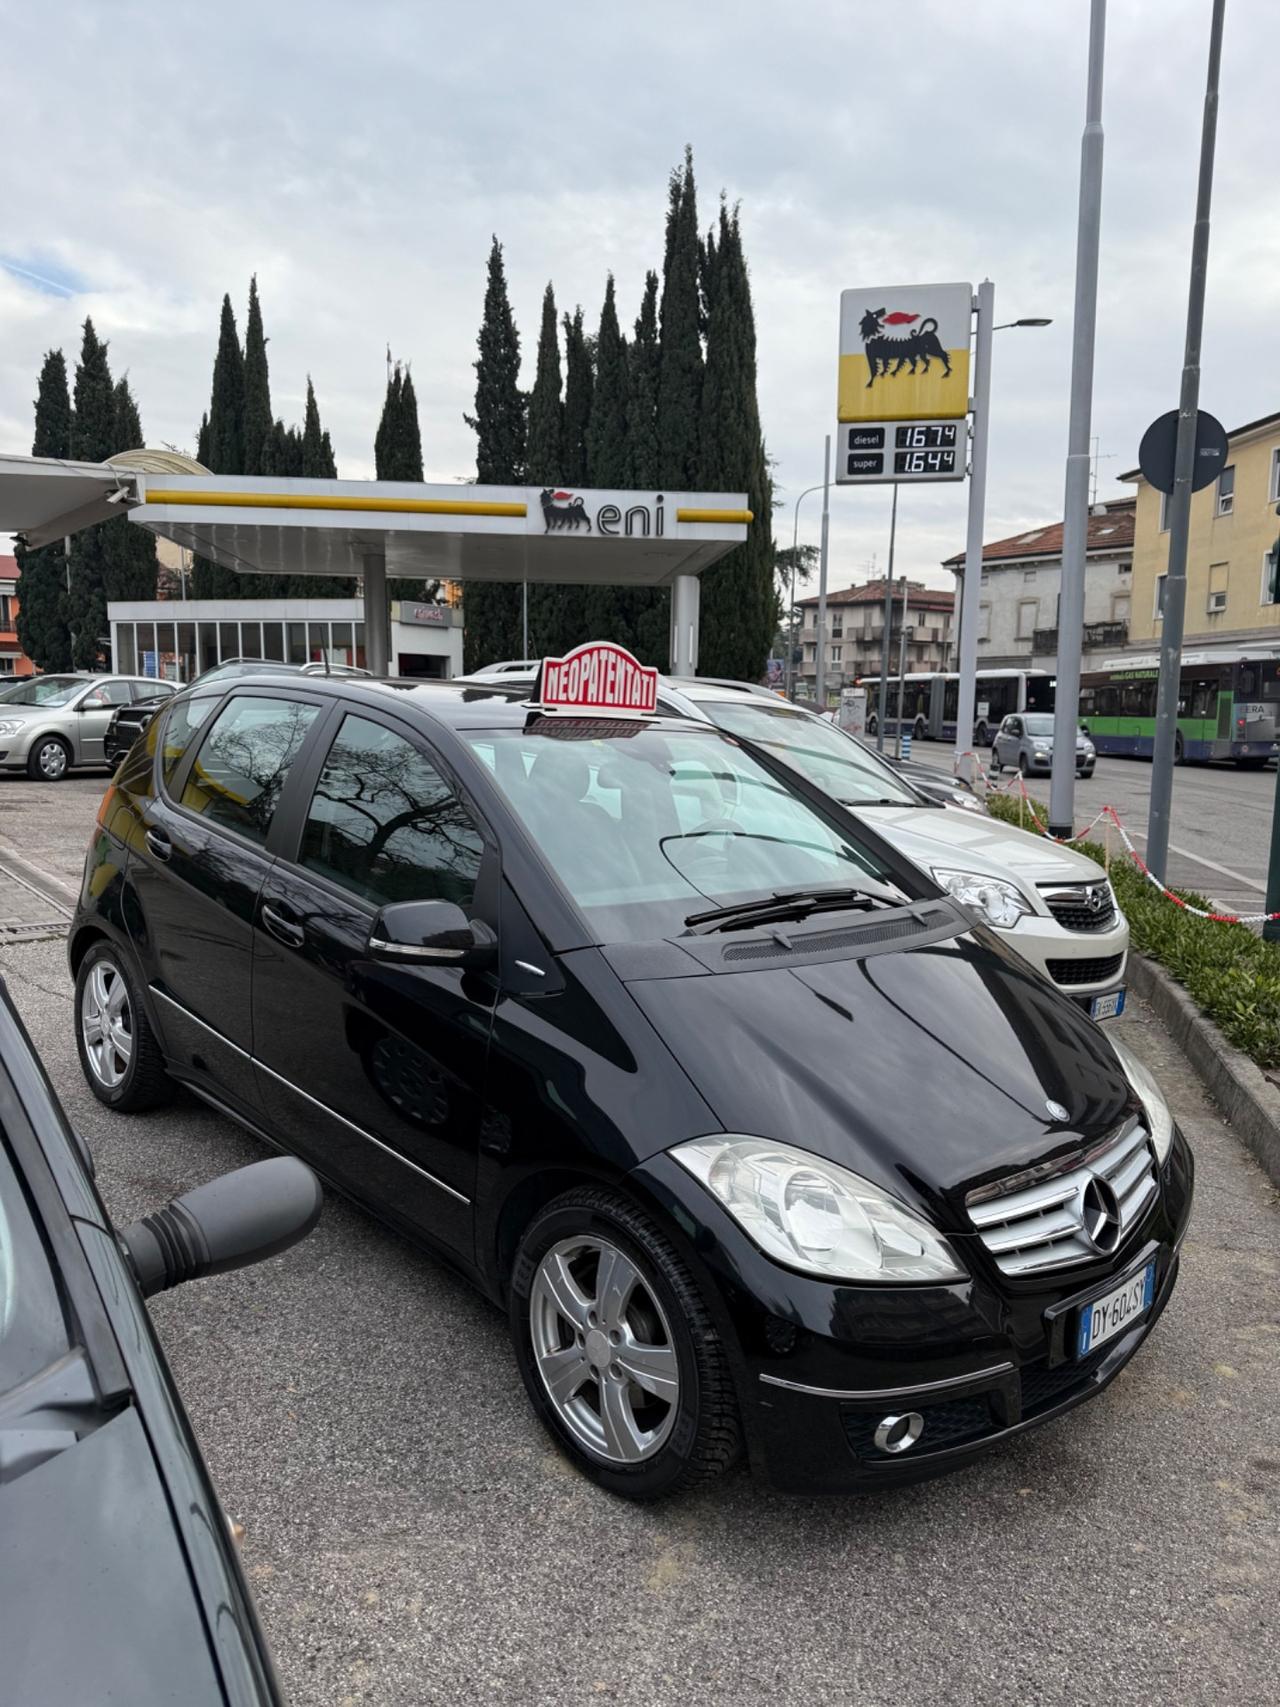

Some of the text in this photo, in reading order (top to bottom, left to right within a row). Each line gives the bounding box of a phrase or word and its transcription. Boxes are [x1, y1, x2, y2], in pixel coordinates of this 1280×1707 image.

[854, 434, 879, 445] diesel
[853, 459, 877, 470] super
[596, 494, 665, 537] eni
[546, 649, 654, 708] NEOPATENTATI
